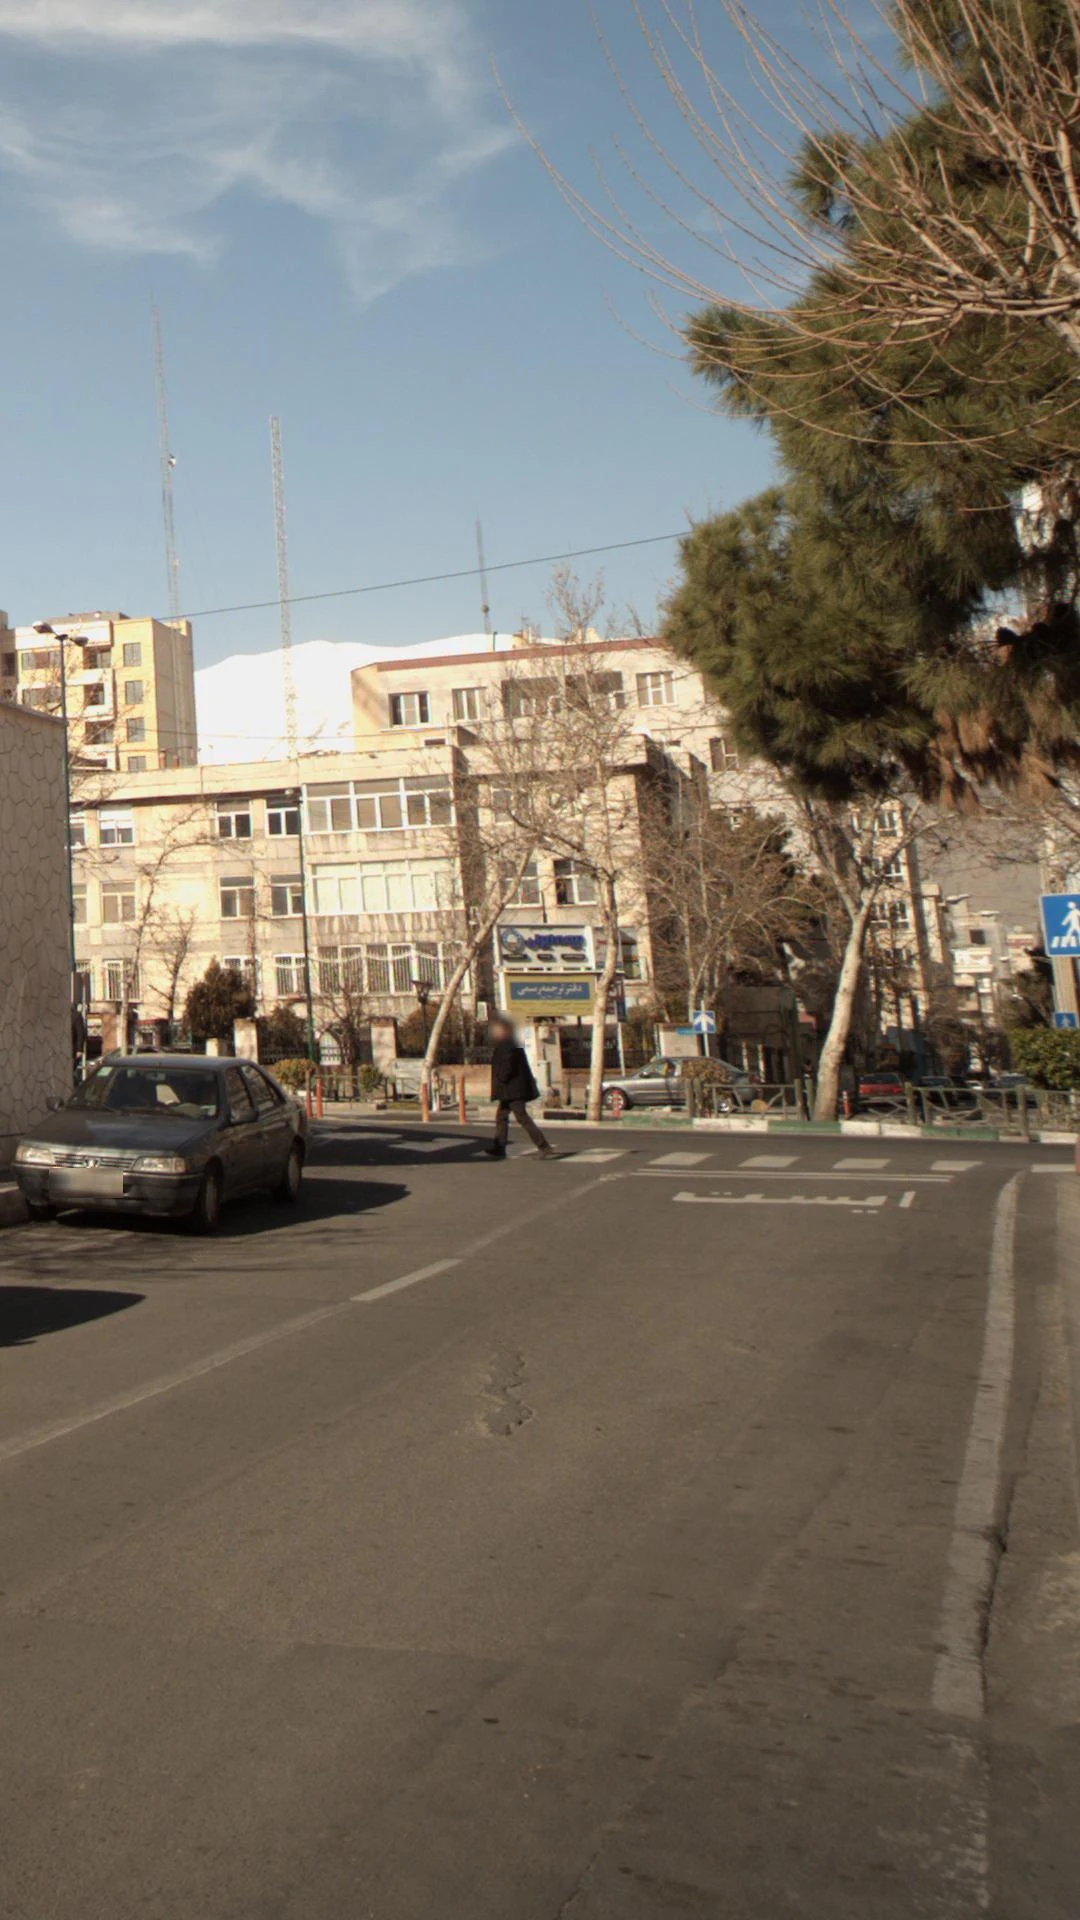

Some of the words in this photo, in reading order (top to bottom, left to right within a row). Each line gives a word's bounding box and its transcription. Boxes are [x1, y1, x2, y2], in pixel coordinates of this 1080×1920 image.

[517, 985, 544, 996] رسمی
[543, 983, 566, 995] ترجمه
[566, 984, 584, 995] دفتر
[672, 1191, 917, 1214] ایست
